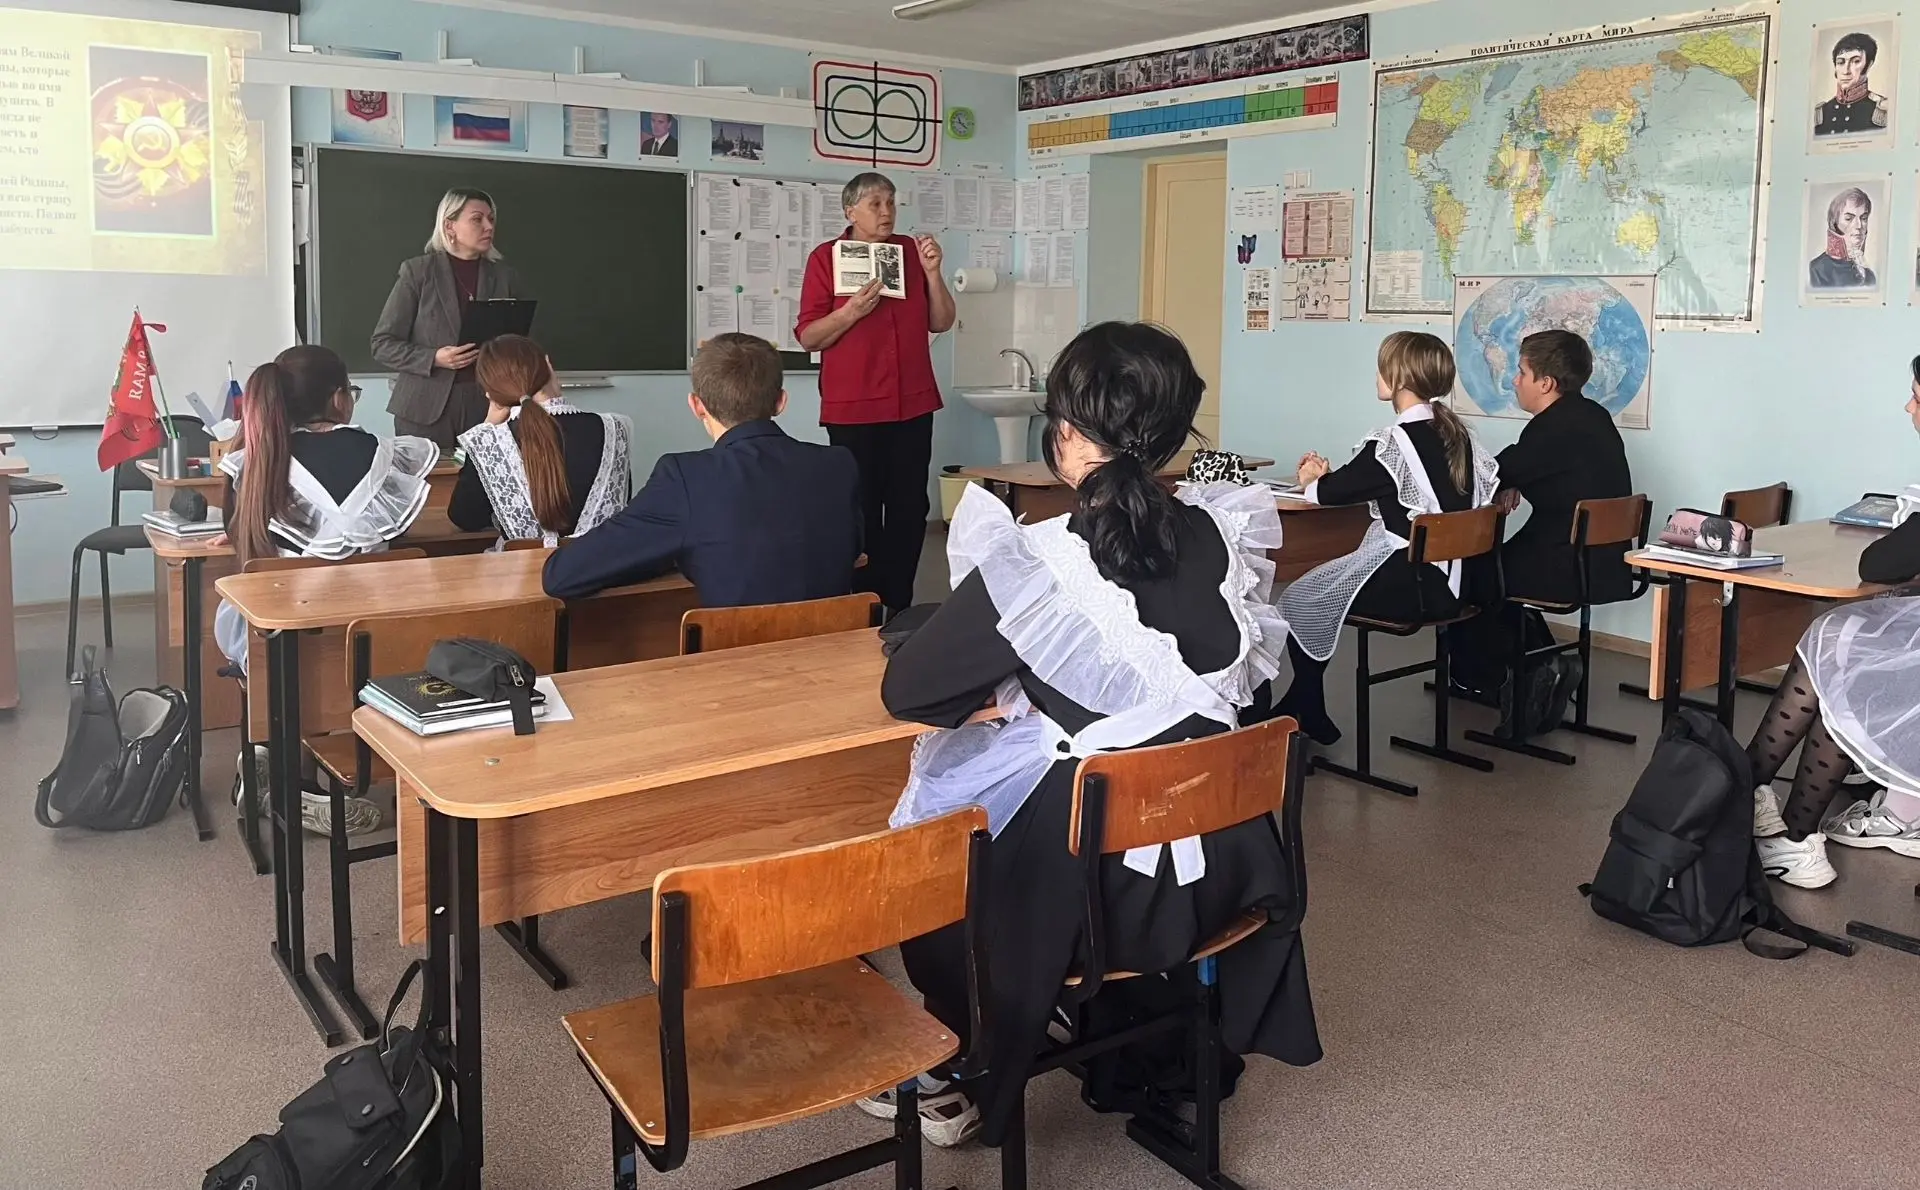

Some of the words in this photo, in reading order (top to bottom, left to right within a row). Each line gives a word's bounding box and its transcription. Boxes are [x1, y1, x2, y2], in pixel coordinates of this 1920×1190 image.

[1470, 38, 1550, 56] ПОЛИТИЧЕСКАЯ
[1557, 32, 1593, 44] КАРТА
[1602, 26, 1634, 38] МИРА
[21, 46, 71, 60] Великой
[22, 66, 71, 78] которые
[39, 83, 61, 92] имя
[46, 97, 54, 107] В
[33, 195, 71, 207] страну
[36, 208, 78, 220] Подвиг
